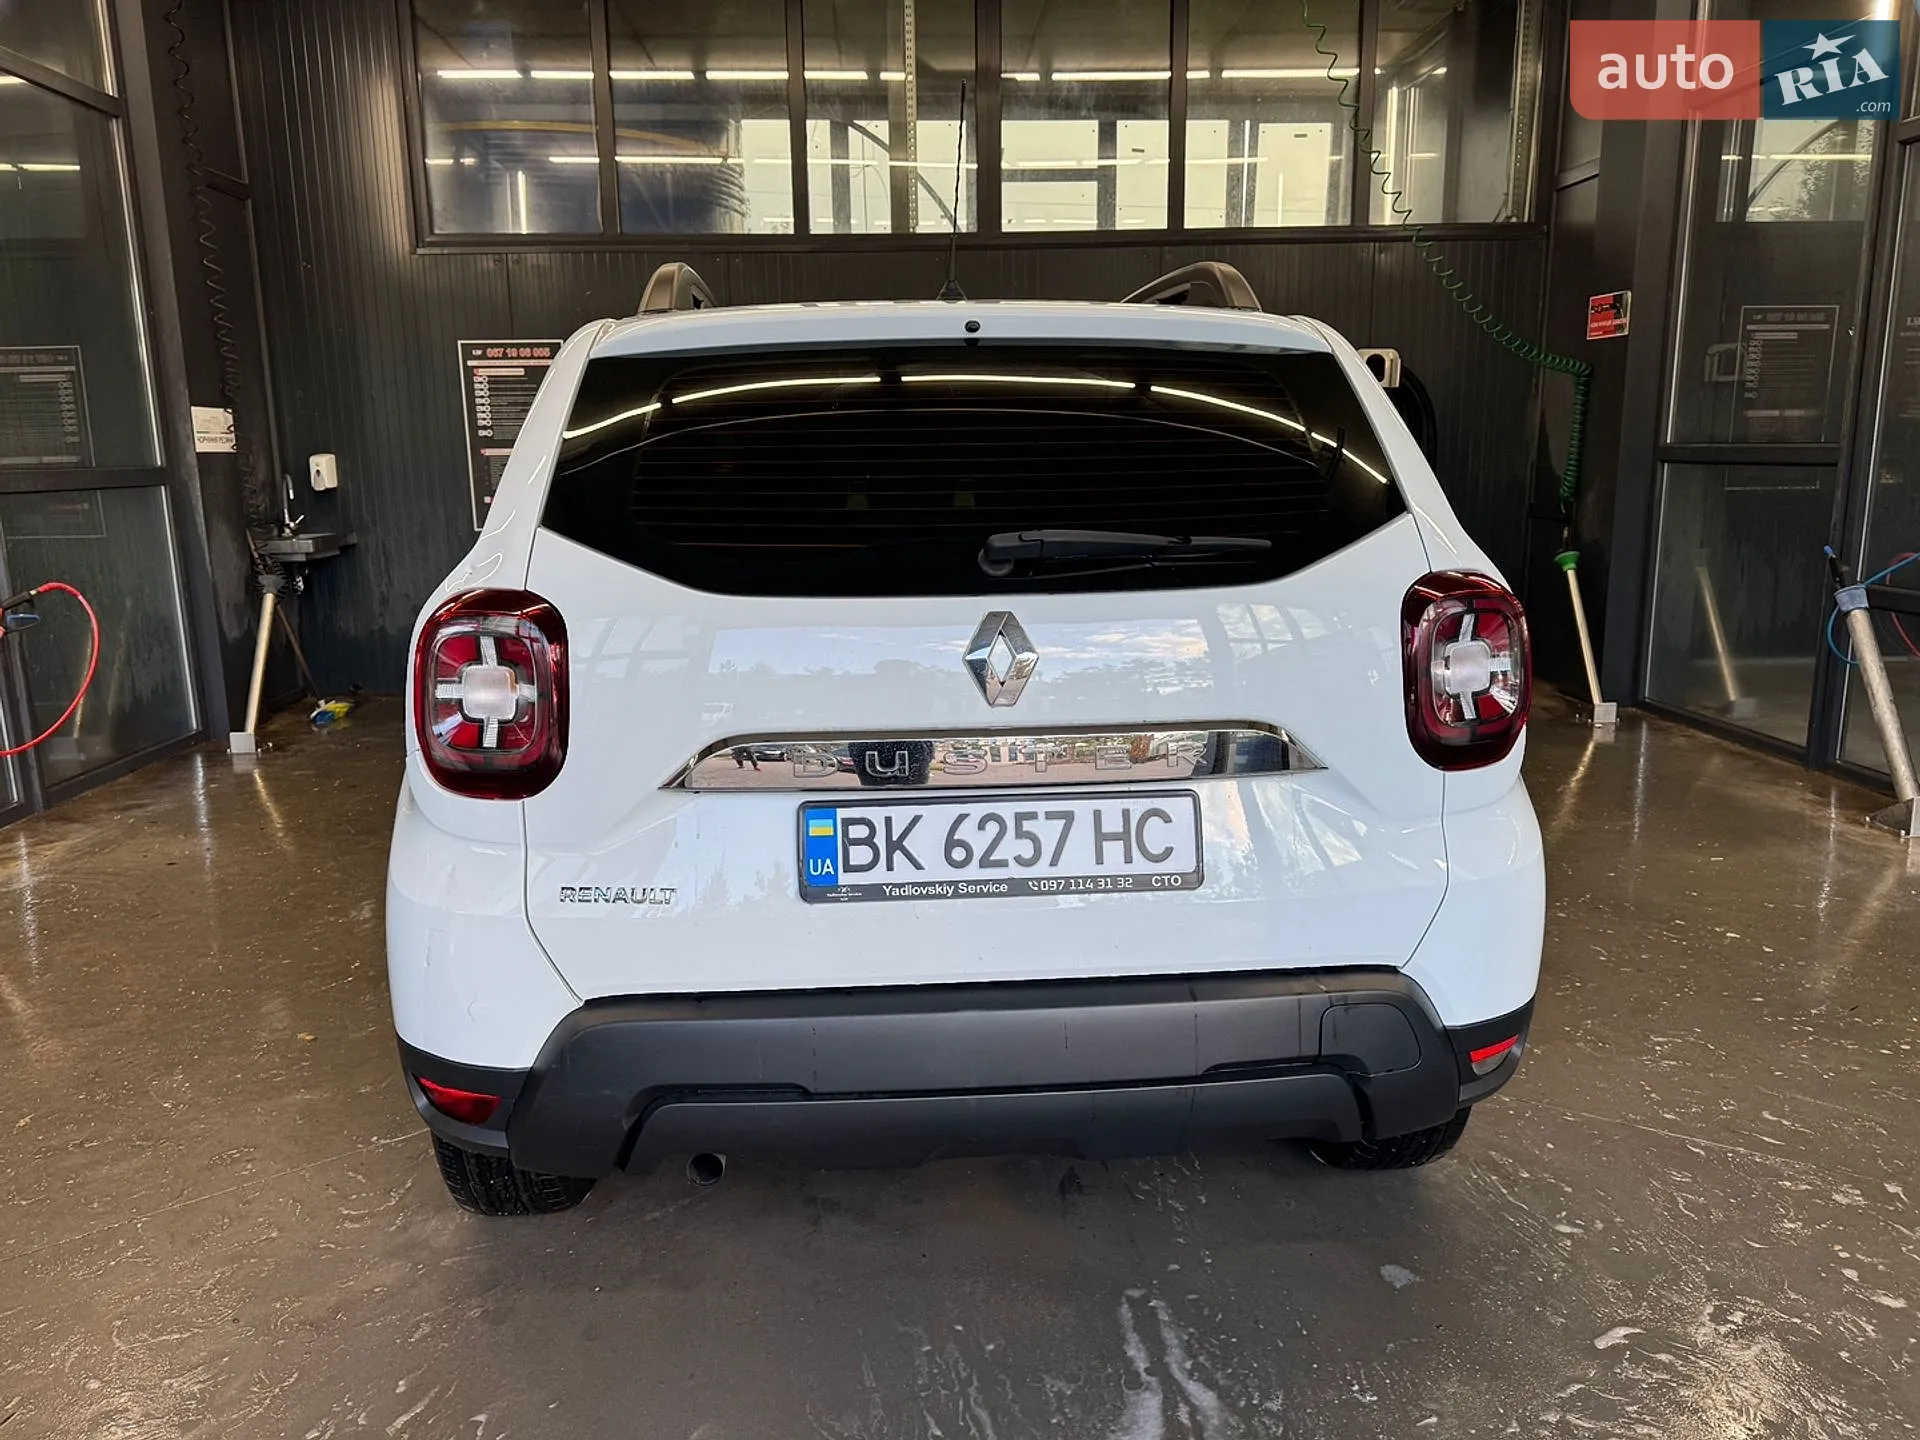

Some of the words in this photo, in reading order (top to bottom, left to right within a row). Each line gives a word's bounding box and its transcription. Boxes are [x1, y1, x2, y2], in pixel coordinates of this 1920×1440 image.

[791, 742, 1208, 779] DUSTER
[842, 813, 924, 874] BK
[944, 810, 1075, 870] 6257
[1093, 807, 1174, 866] HC
[809, 857, 835, 876] UA
[882, 882, 955, 898] Yadlovskiy
[957, 880, 1009, 895] Service
[1040, 878, 1066, 891] 097
[1069, 877, 1094, 890] 114
[1096, 876, 1113, 889] 31
[1115, 876, 1134, 889] 32
[559, 886, 677, 905] RENAULT
